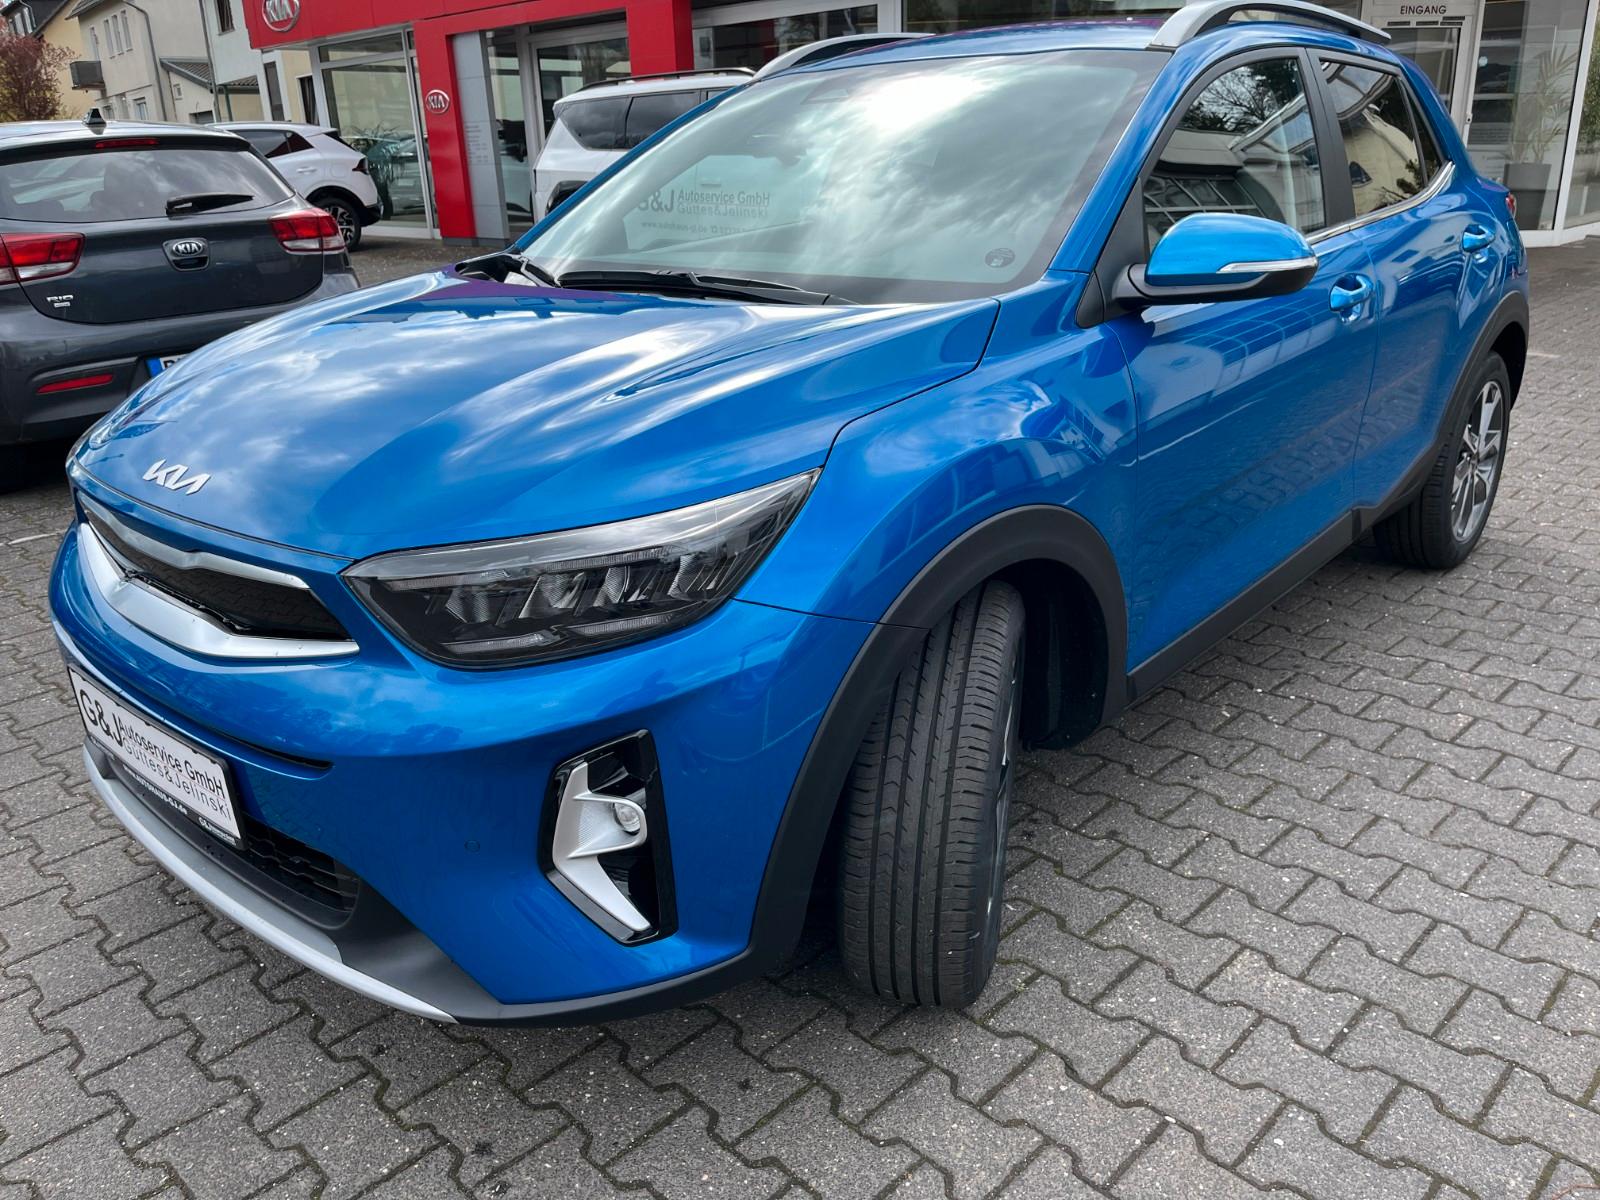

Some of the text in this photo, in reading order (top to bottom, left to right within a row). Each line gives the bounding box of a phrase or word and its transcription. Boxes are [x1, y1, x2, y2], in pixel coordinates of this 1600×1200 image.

[1400, 5, 1447, 15] EINGANG
[678, 190, 771, 206] Autoservice GmbH
[46, 294, 74, 302] RIO
[79, 689, 123, 747] G&J
[117, 715, 183, 773] Autoservice
[184, 760, 226, 800] GmbH
